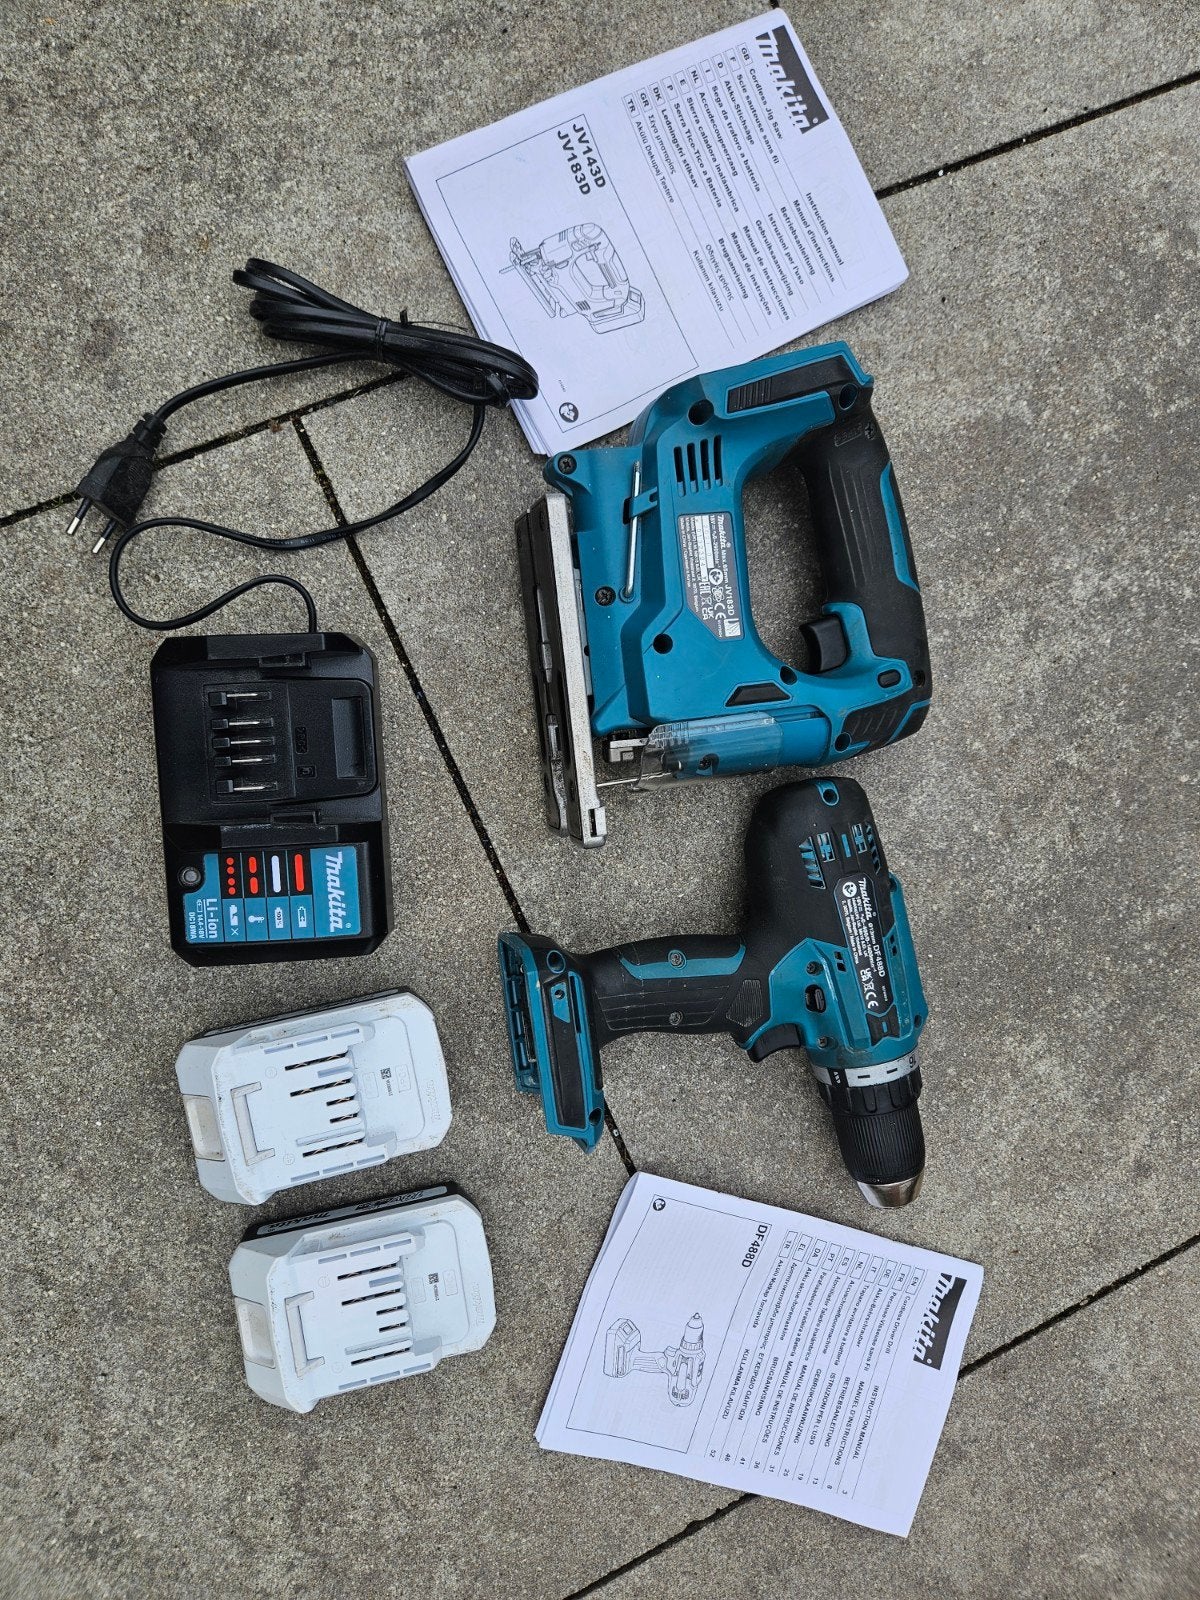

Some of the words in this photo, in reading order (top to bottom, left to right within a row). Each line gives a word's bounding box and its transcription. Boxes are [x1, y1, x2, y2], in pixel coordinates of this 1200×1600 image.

[639, 91, 649, 107] GR
[739, 47, 749, 60] GB
[748, 68, 769, 105] Cordless
[764, 105, 776, 120] Jig
[771, 121, 784, 140] Saw
[691, 69, 700, 83] NL
[697, 91, 739, 177] Accudecoupeerzaag
[723, 79, 756, 145] Akku-Stichsäge
[736, 73, 749, 93] Scie
[745, 94, 766, 132] sauteuse
[762, 133, 775, 154] sans
[771, 154, 779, 164] fil
[652, 86, 662, 101] DK
[659, 108, 686, 157] Ledningsfri
[681, 158, 699, 189] stiksav
[685, 97, 702, 124] Sierra
[697, 125, 718, 162] caladora
[710, 85, 725, 108] Sega
[720, 108, 730, 120] da
[726, 121, 743, 151] traforo
[742, 159, 761, 192] batteria
[556, 128, 591, 195] JV183D
[571, 121, 607, 189] JV143D
[626, 98, 636, 112] TR
[644, 144, 663, 176] Dekupaj
[658, 176, 675, 203] Testere
[673, 102, 688, 127] Serra
[684, 128, 705, 167] Tico-Tico
[705, 177, 723, 207] Bateria
[792, 199, 810, 228] Manuel
[805, 192, 830, 235] Instruction
[826, 236, 844, 265] manual
[767, 212, 789, 250] Istruzioni
[785, 251, 795, 264] per
[779, 206, 816, 275] Betriebsanleitung
[717, 237, 749, 299] Brugsanvisning
[754, 219, 794, 296] Gebruiksaanwijzing
[729, 231, 747, 261] Manual
[743, 261, 753, 273] de
[748, 273, 773, 316] instruções
[742, 225, 760, 255] Manual
[756, 255, 765, 266] de
[761, 267, 791, 321] instrucciones
[725, 584, 734, 615] JV183D
[188, 911, 196, 939] DC18WA
[205, 897, 220, 938] Li-ion
[872, 944, 885, 977] DF488D
[740, 1224, 767, 1268] DF488D
[797, 1243, 805, 1251] EL
[812, 1248, 820, 1258] DA
[840, 1256, 849, 1266] ES
[801, 1267, 812, 1282] Akku
[855, 1261, 863, 1270] NL
[883, 1269, 891, 1278] DE
[896, 1272, 905, 1282] FR
[910, 1276, 918, 1286] EN
[751, 1298, 767, 1328] Tornavida
[889, 1321, 900, 1340] Driver
[732, 1348, 749, 1386] KULLANMA
[865, 1346, 875, 1362] sans
[754, 1356, 778, 1416] BRUGSANVISNING
[779, 1360, 793, 1388] MANUAL
[793, 1364, 807, 1391] MANUAL
[775, 1389, 783, 1399] DE
[790, 1392, 798, 1401] DE
[819, 1372, 836, 1409] ISTRUZIONI
[850, 1380, 864, 1410] MANUEL
[815, 1409, 824, 1424] PER
[823, 1376, 850, 1447] BETRIEBSANLEITUNG
[860, 1385, 879, 1430] INSTRUCTION
[710, 1449, 717, 1457] 52
[851, 1430, 865, 1460] MANUAL
[738, 1457, 746, 1465] 41
[753, 1460, 761, 1469] 36
[768, 1464, 775, 1472] 31
[782, 1468, 789, 1477] 25
[797, 1472, 804, 1480] 19
